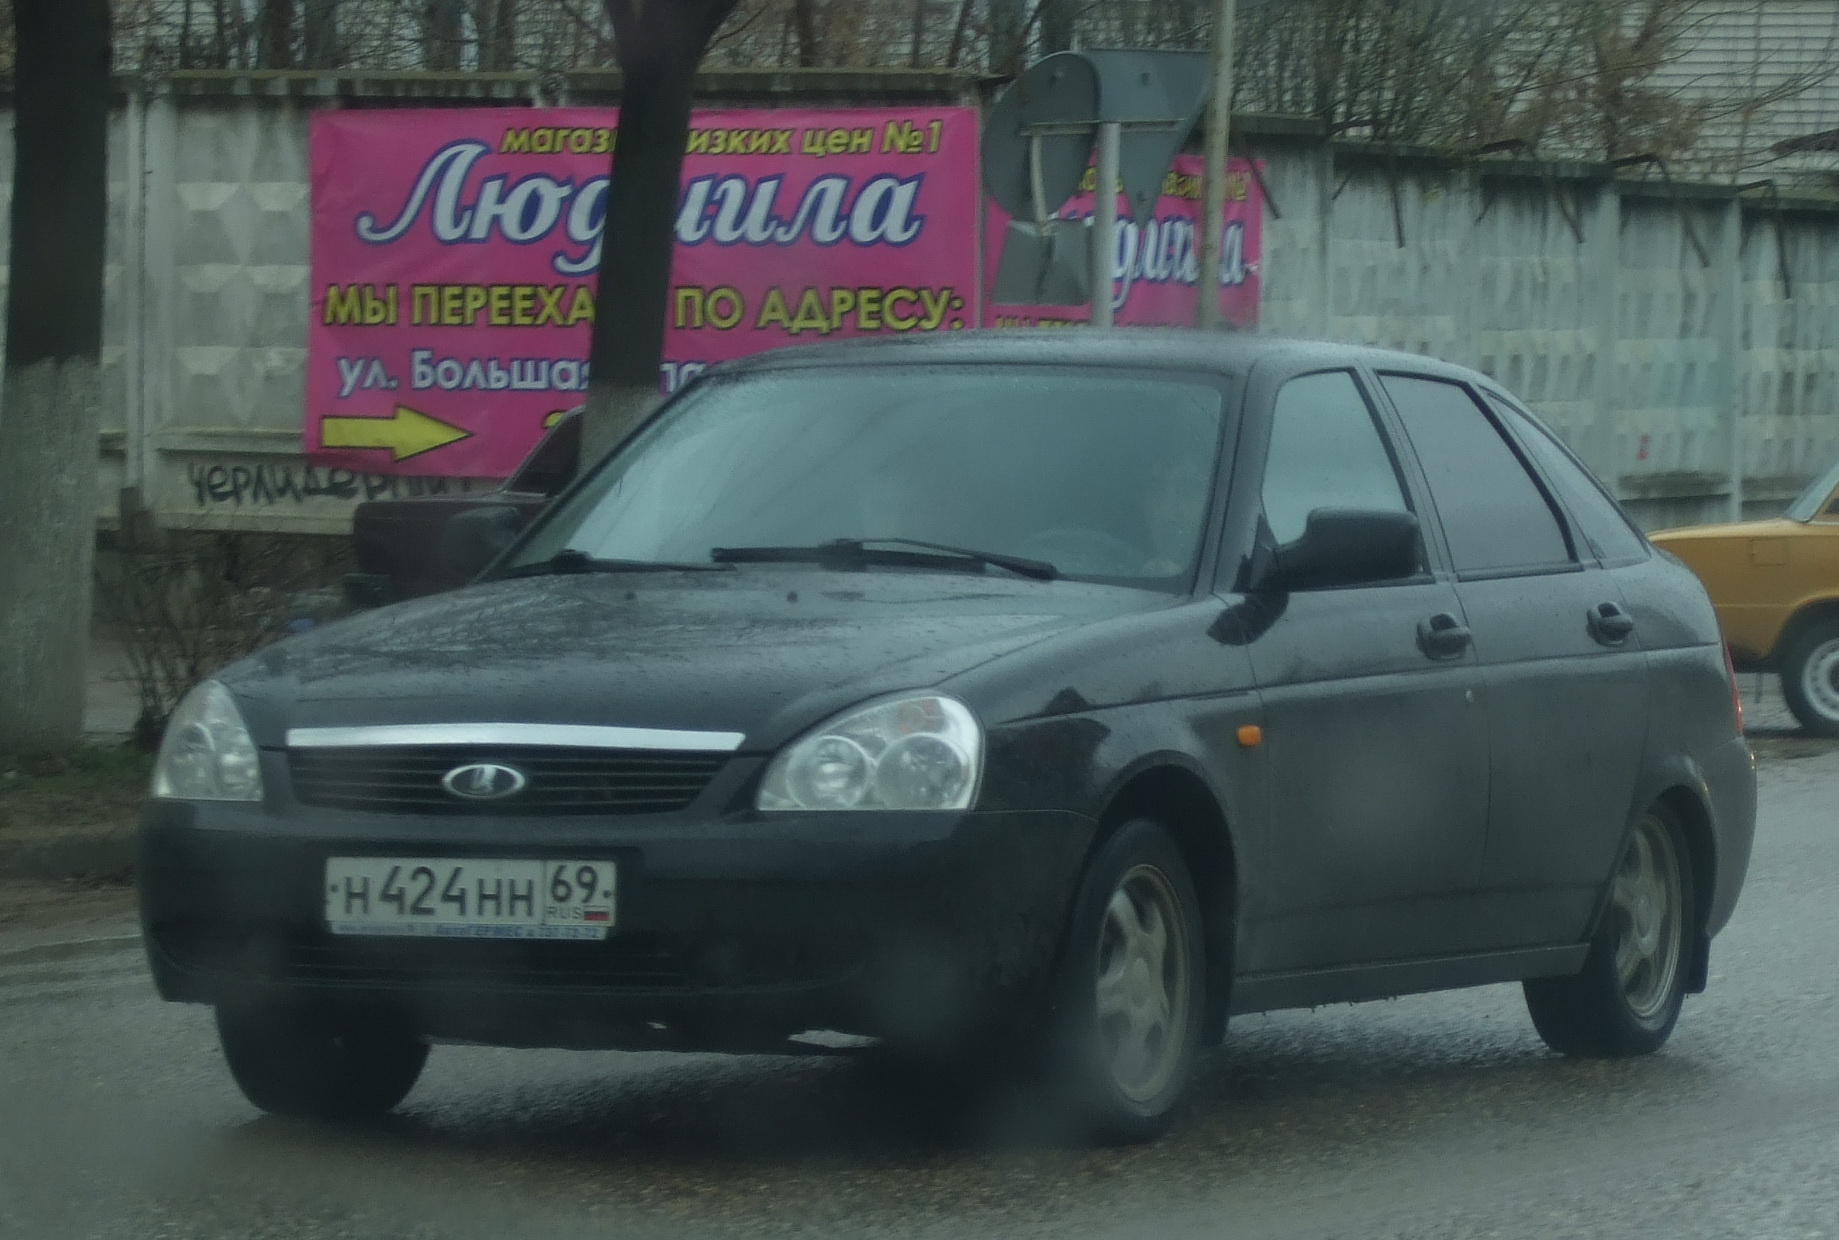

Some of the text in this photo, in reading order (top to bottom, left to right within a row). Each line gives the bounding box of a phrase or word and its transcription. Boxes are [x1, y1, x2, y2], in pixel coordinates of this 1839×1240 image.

[500, 119, 941, 156] магаз изких цен №1
[323, 284, 965, 334] МЫ ПЕРЕЕХА ПО АДРЕСУ:
[337, 356, 398, 397] ул.
[551, 865, 597, 903] 69
